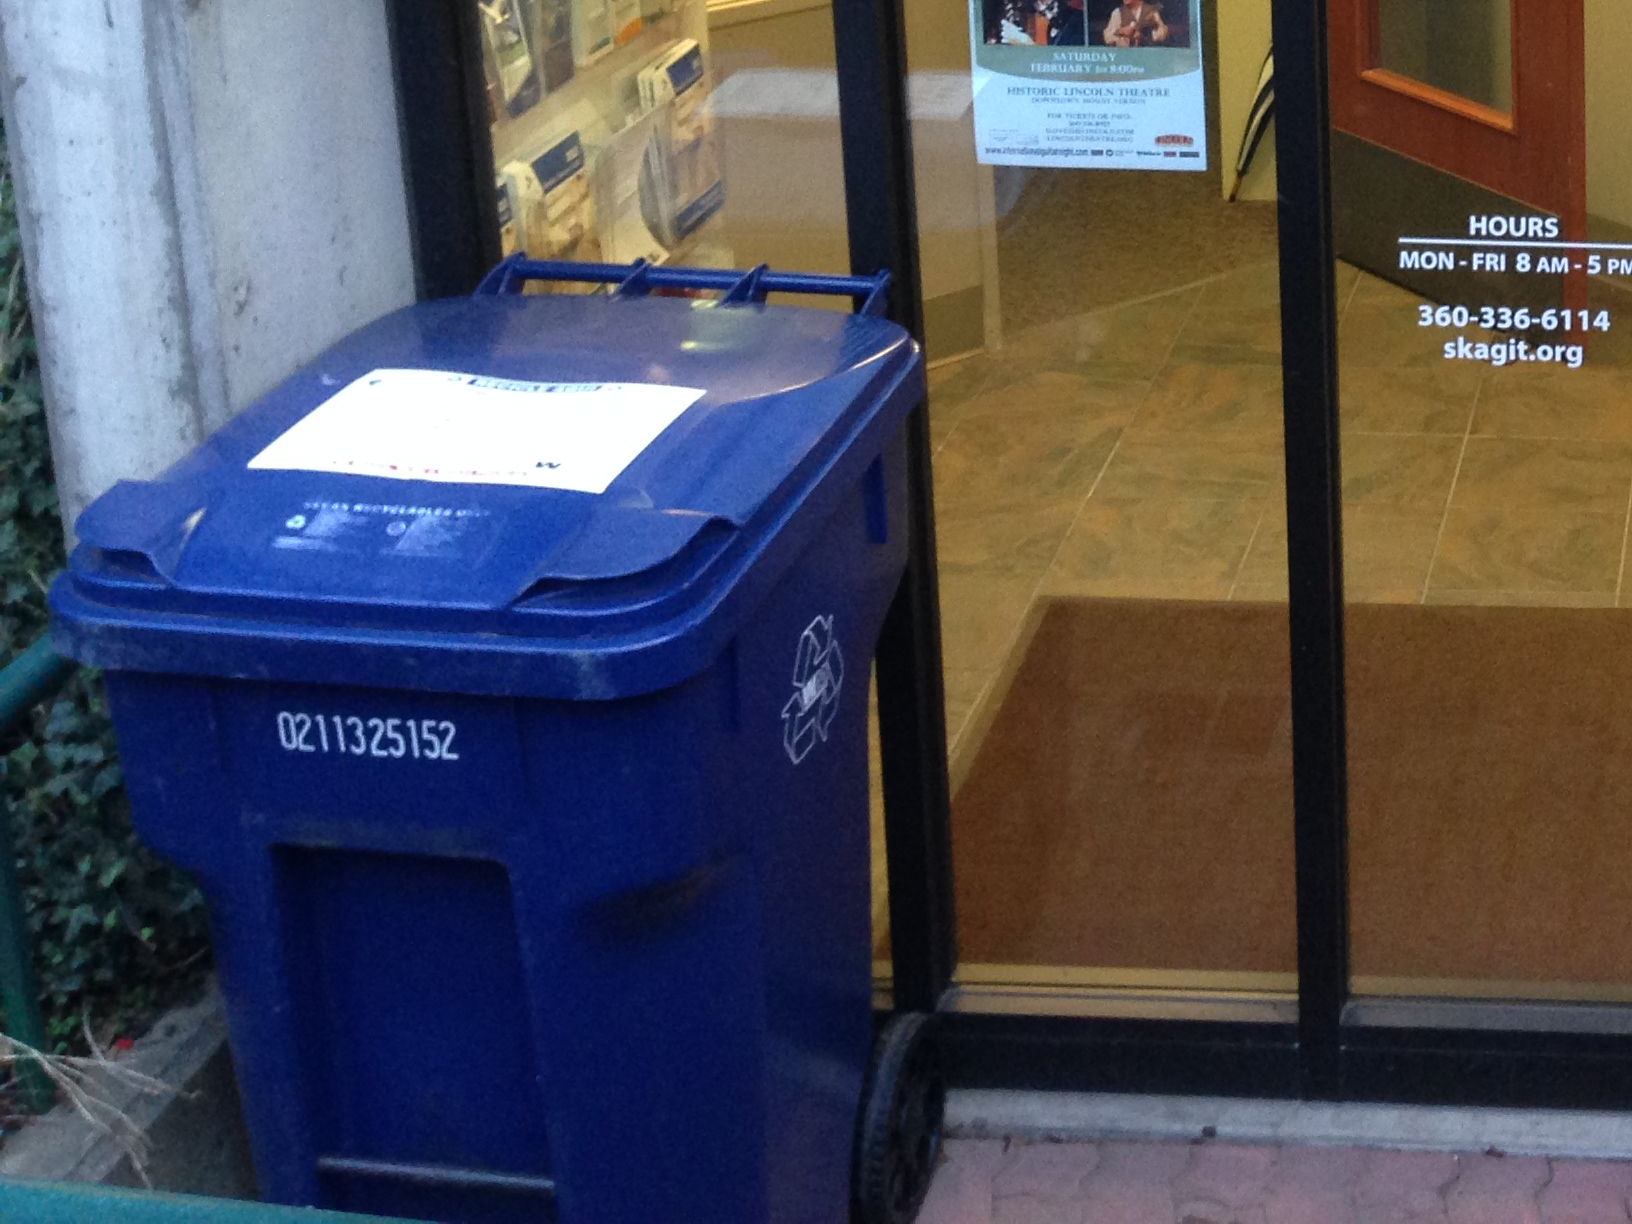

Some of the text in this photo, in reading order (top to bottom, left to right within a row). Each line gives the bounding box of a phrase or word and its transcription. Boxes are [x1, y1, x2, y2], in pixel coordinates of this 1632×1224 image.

[1030, 62, 1092, 74] FEBRUARY
[1052, 51, 1117, 63] SATURDAY
[1006, 86, 1171, 97] HISTORIC LINCOLN THEATRE
[1469, 214, 1560, 239] HOURS
[1399, 250, 1455, 271] MON
[1472, 252, 1506, 272] FRI
[1516, 253, 1531, 273] 8
[1536, 257, 1569, 274] AM
[1587, 255, 1601, 275] 5
[1417, 304, 1611, 332] 360-336-6114
[1443, 336, 1584, 368] skagit.org
[278, 711, 459, 761] 0211325152
